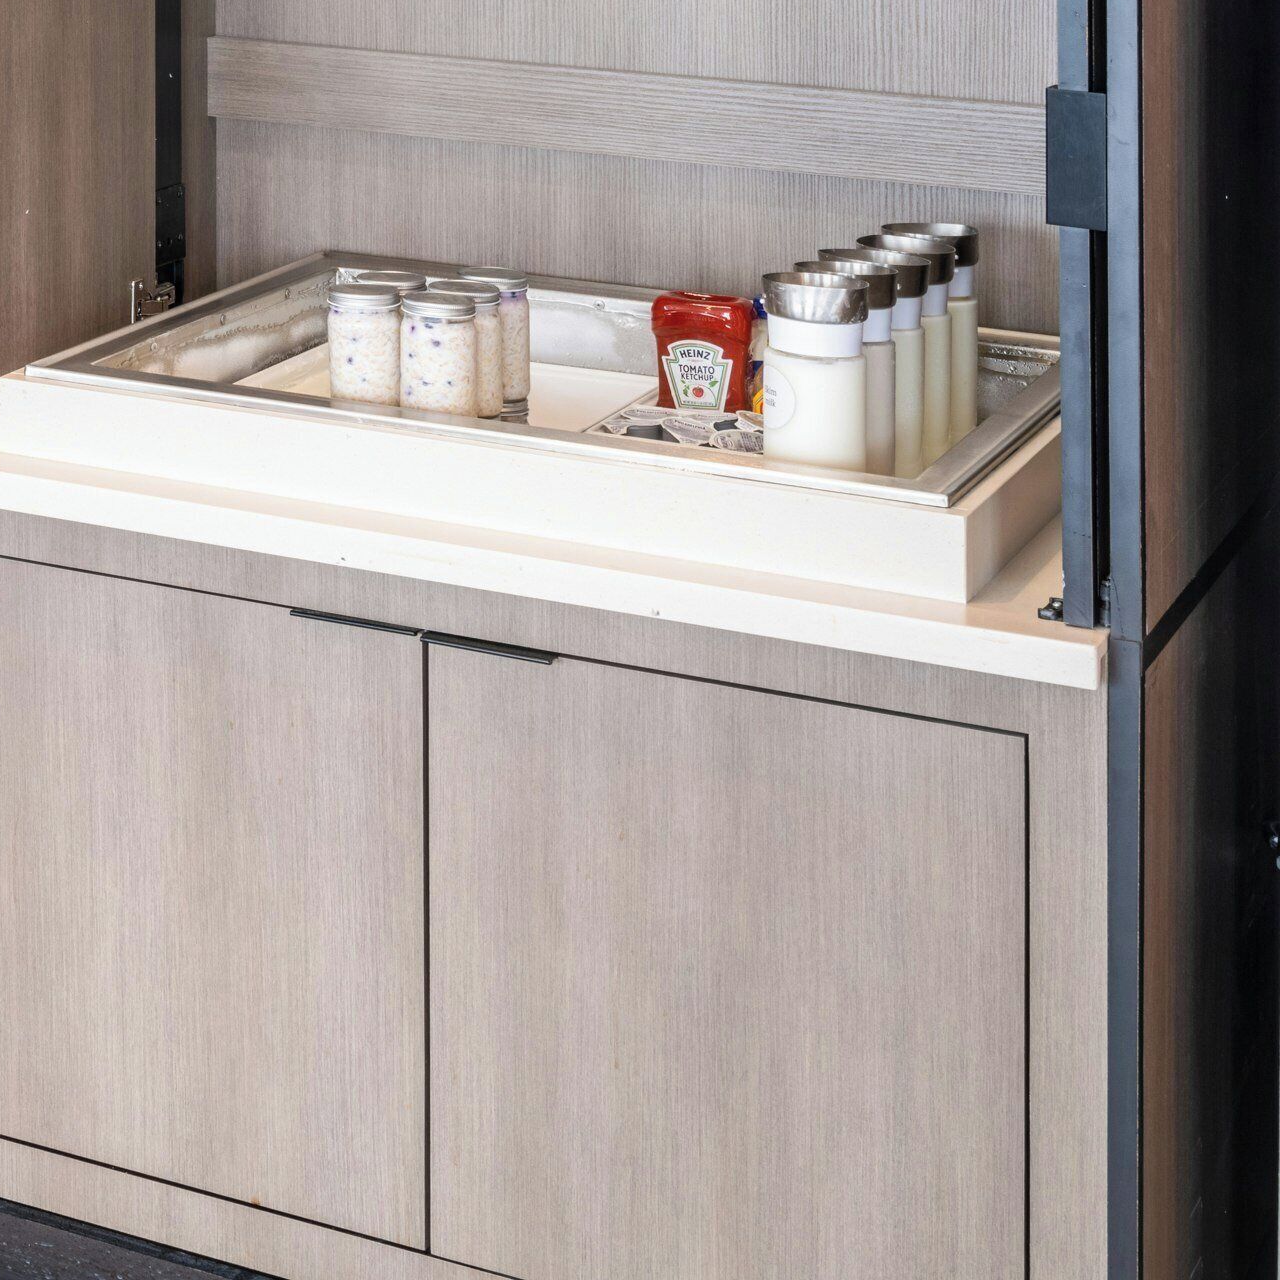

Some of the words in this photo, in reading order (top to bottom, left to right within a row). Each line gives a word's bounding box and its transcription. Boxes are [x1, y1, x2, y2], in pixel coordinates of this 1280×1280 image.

[679, 349, 711, 360] HEINZ
[678, 364, 715, 375] TOMATO
[680, 373, 714, 381] KETCHUP
